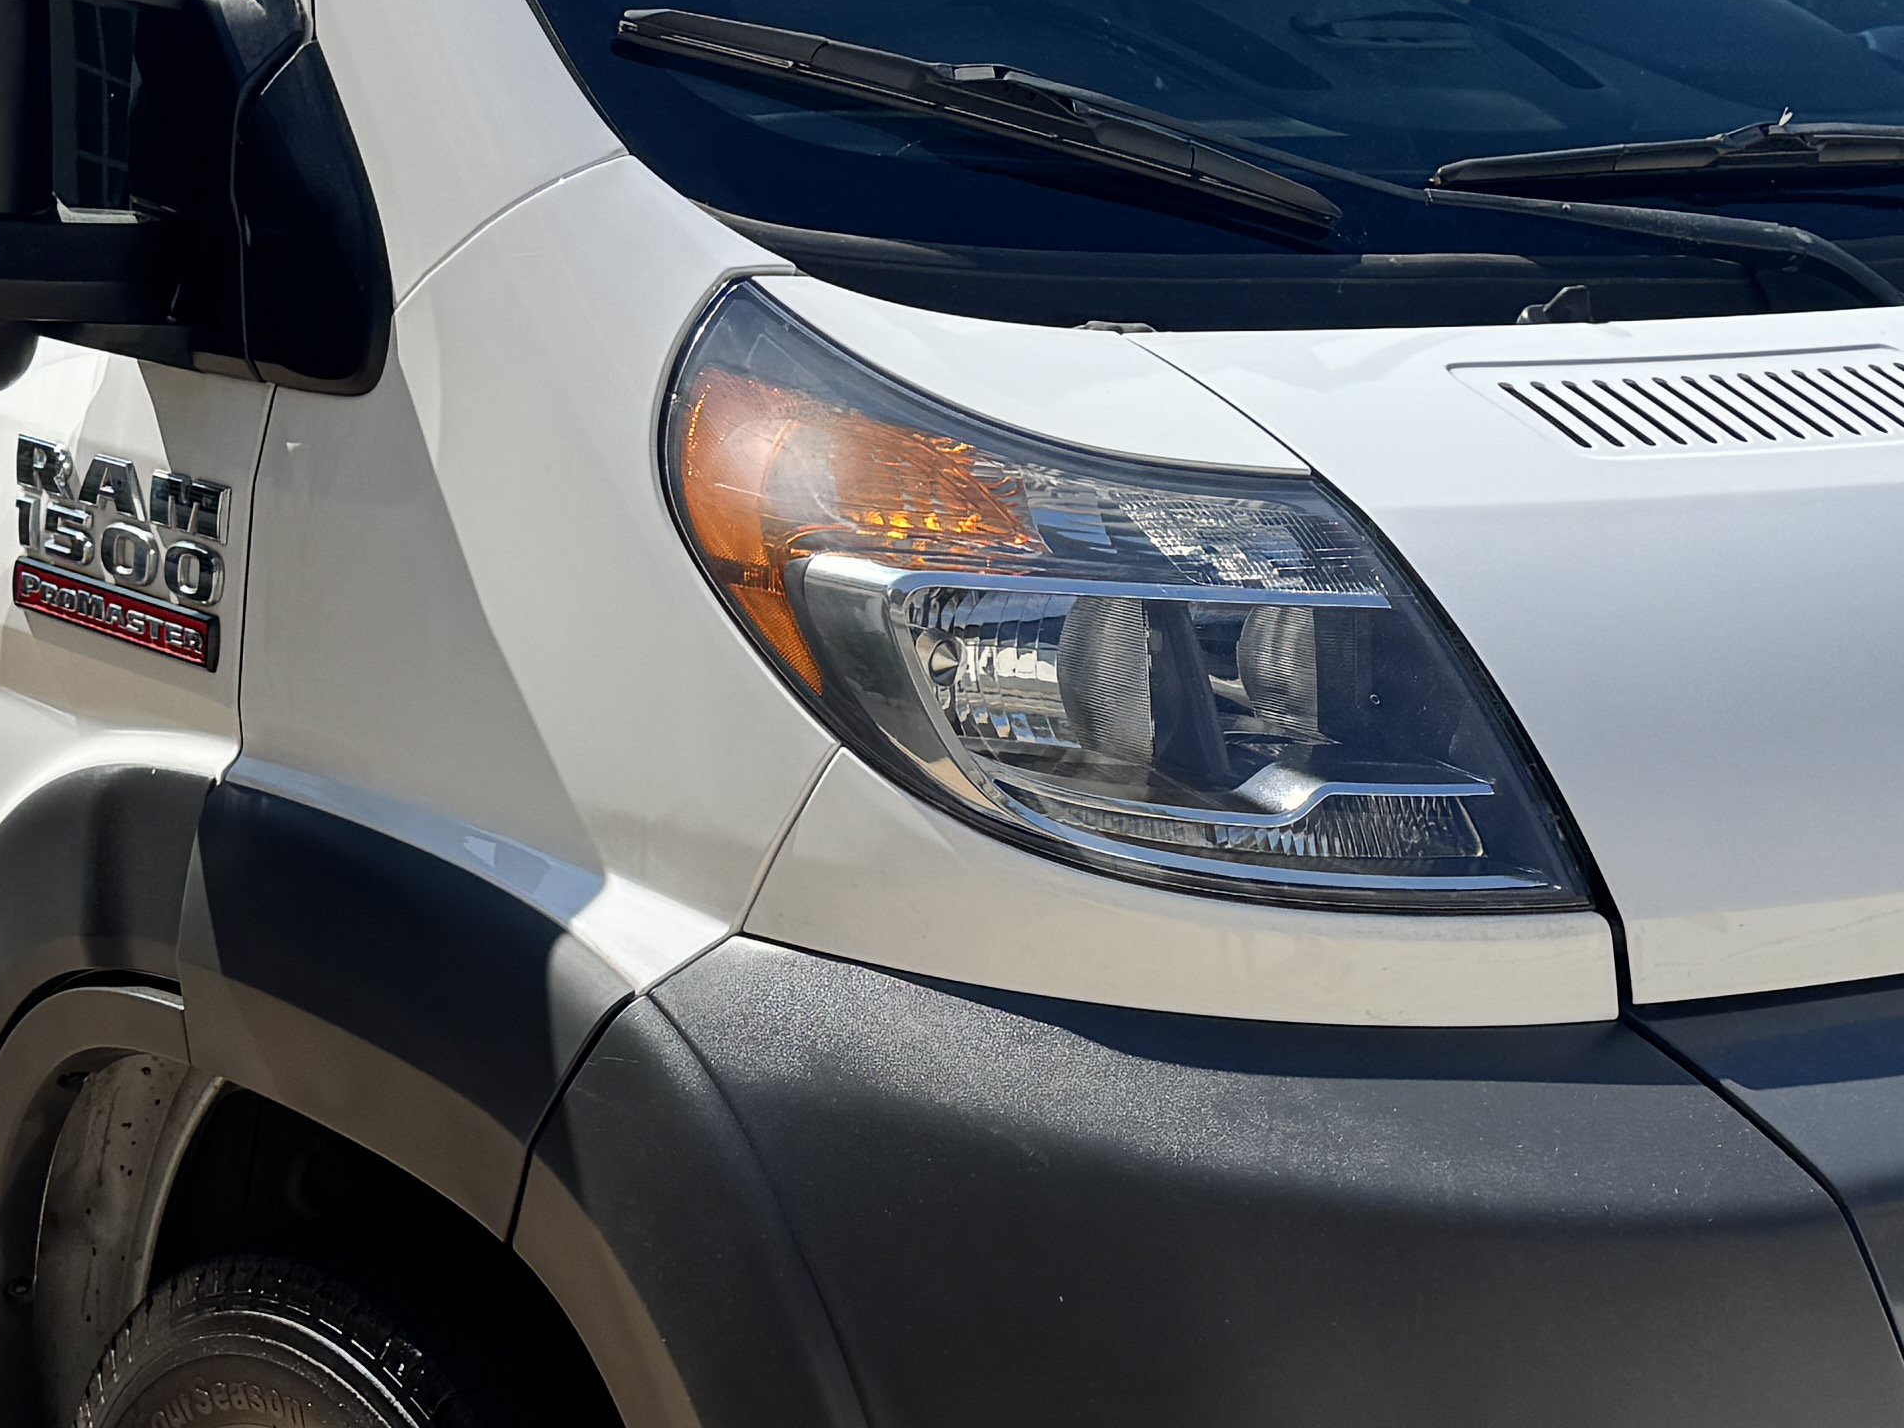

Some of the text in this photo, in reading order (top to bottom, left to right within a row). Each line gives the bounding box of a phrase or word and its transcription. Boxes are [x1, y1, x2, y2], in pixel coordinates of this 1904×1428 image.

[16, 433, 232, 545] RAM
[15, 492, 226, 607] 1500
[20, 571, 204, 655] PROMASTER
